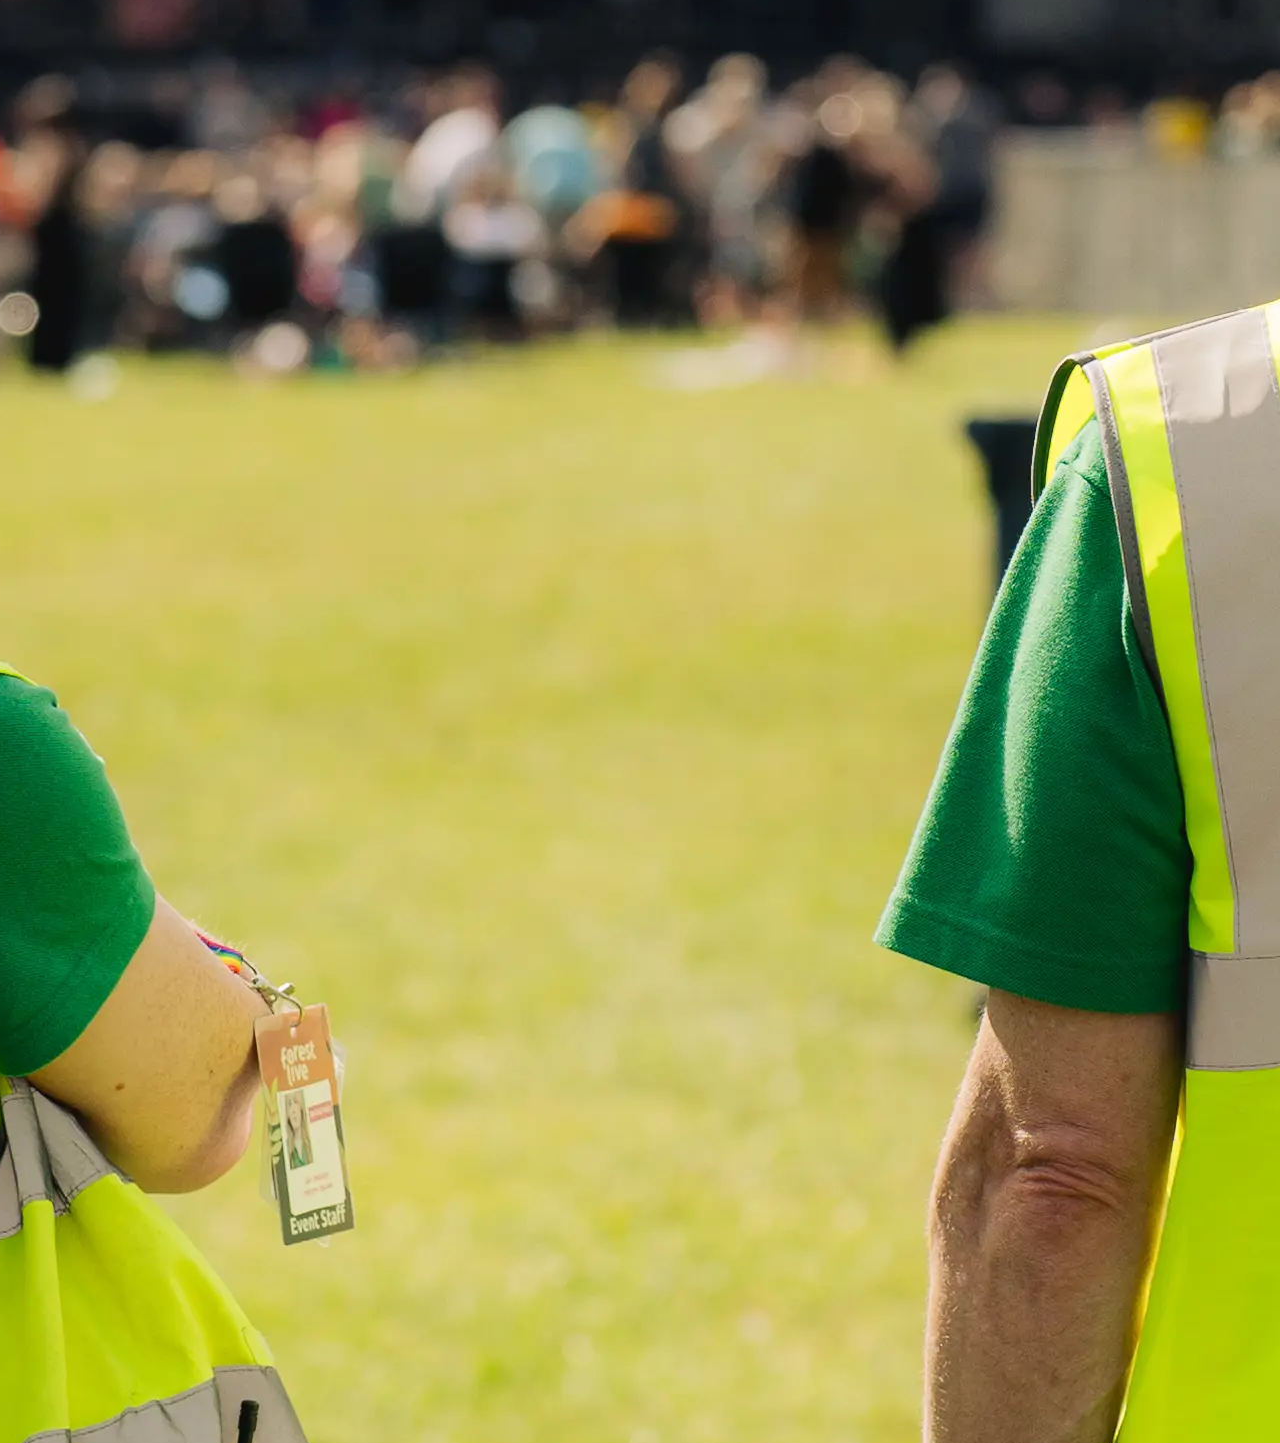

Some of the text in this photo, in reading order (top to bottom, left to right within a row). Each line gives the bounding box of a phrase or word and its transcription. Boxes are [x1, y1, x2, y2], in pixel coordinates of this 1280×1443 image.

[281, 1040, 317, 1070] forest
[286, 1063, 309, 1087] live
[290, 1203, 346, 1235] Event Staff
